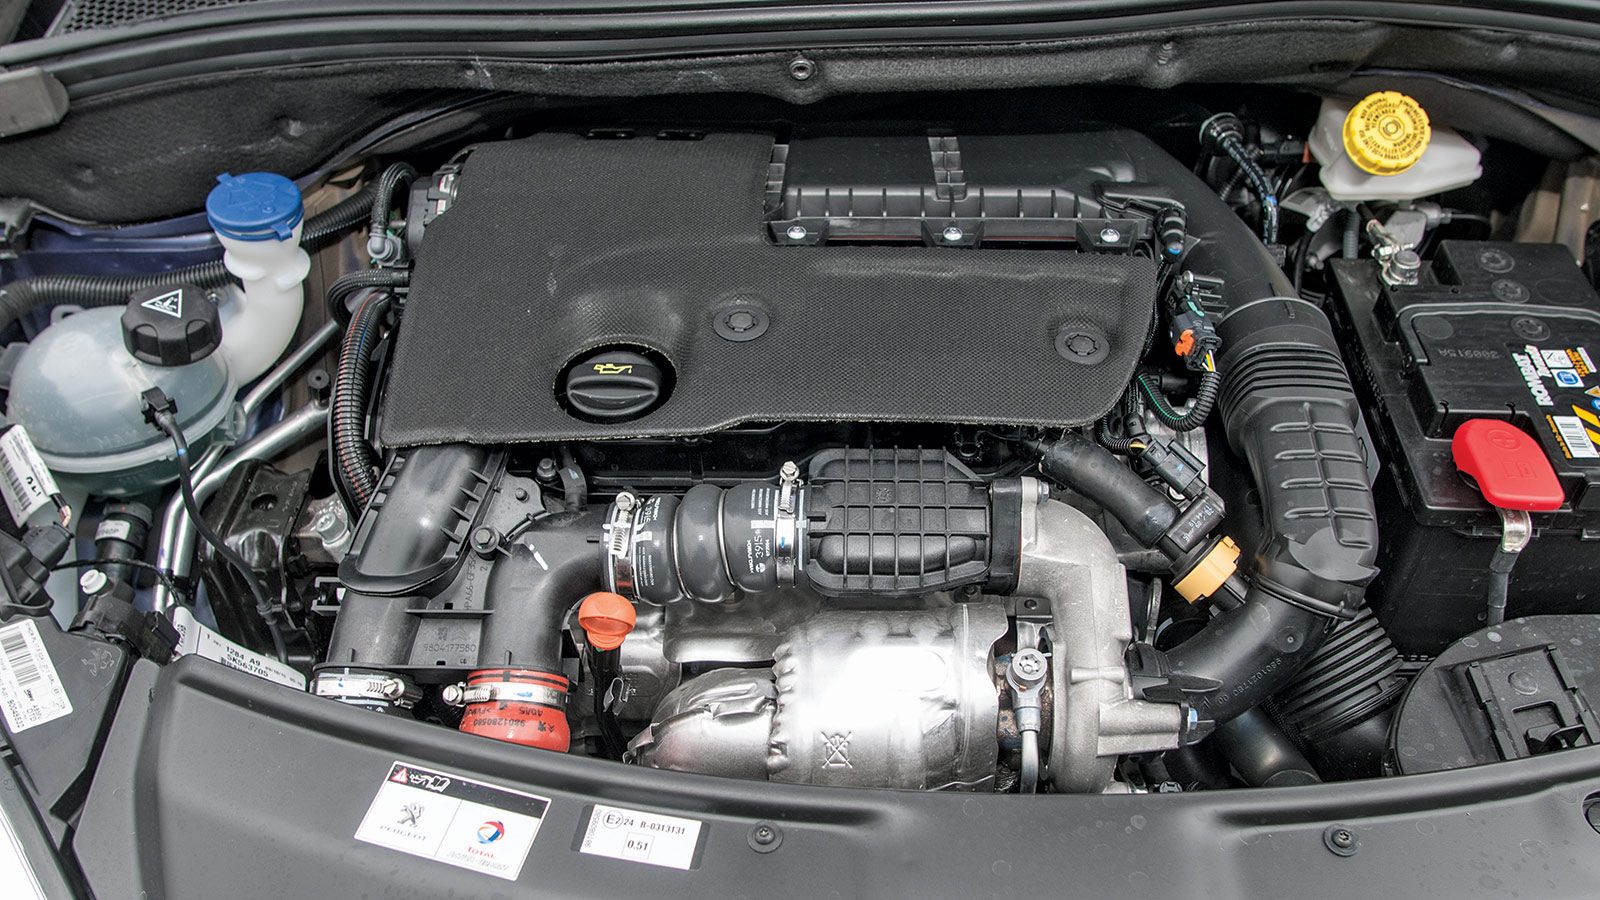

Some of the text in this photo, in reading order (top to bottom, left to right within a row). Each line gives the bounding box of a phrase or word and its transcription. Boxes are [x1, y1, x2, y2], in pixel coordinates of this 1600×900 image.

[226, 646, 245, 660] 1284
[249, 658, 261, 666] A9
[640, 820, 686, 835] R-0313131
[627, 839, 649, 851] 0.51
